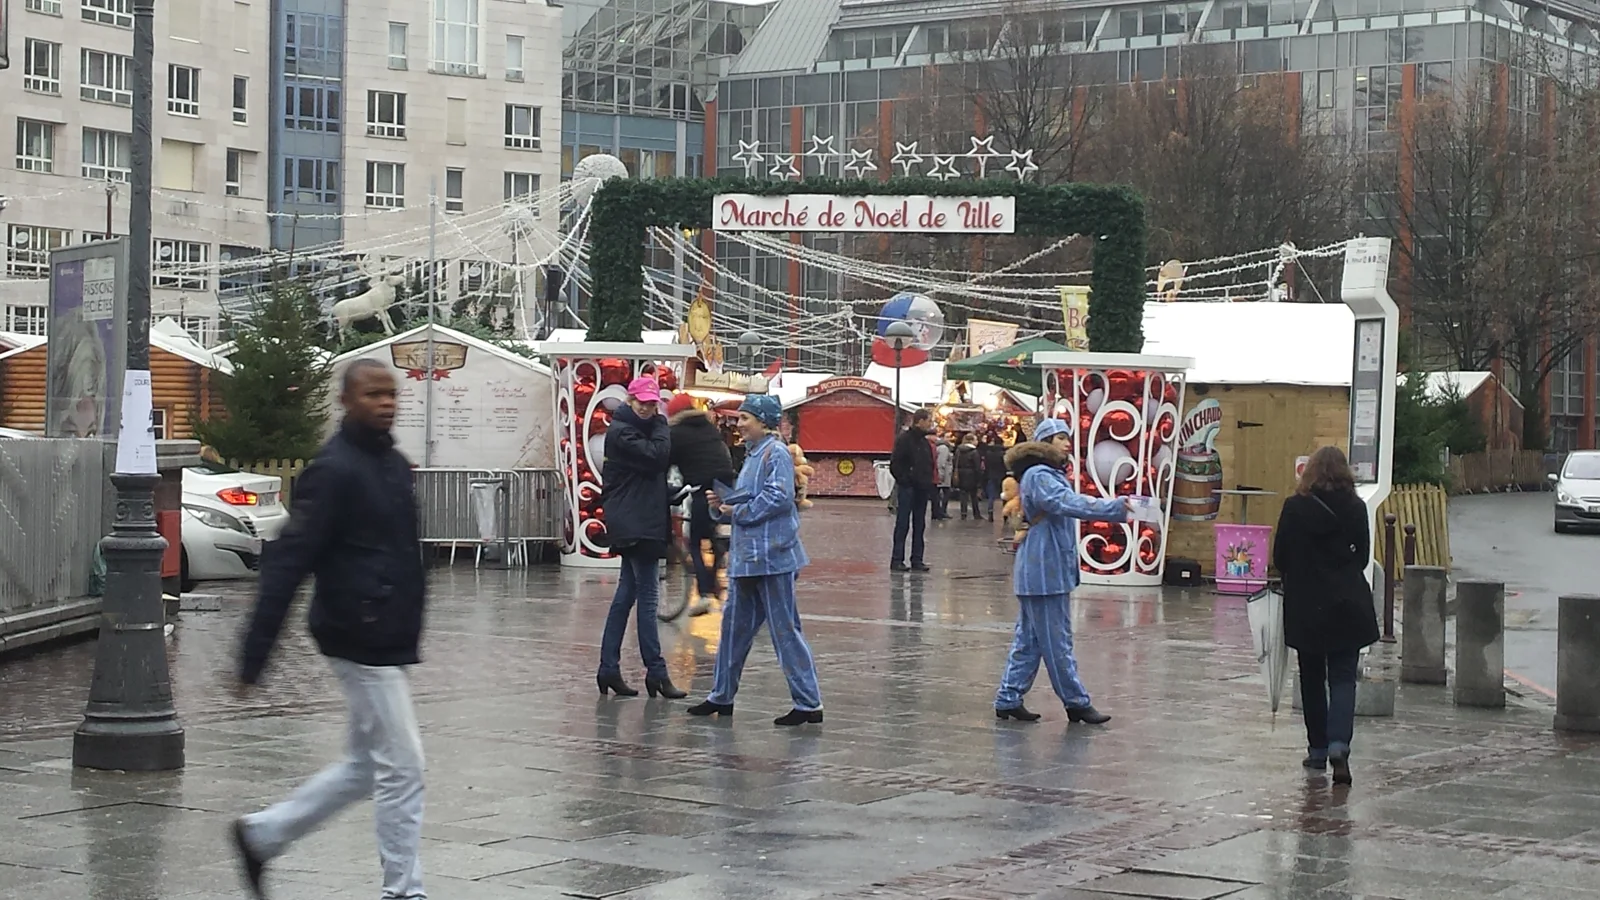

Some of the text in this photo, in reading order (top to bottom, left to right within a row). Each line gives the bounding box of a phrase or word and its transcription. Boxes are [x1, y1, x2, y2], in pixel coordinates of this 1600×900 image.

[720, 198, 1004, 229] Marché de Noël de Lille
[1193, 406, 1222, 431] CHAUD
